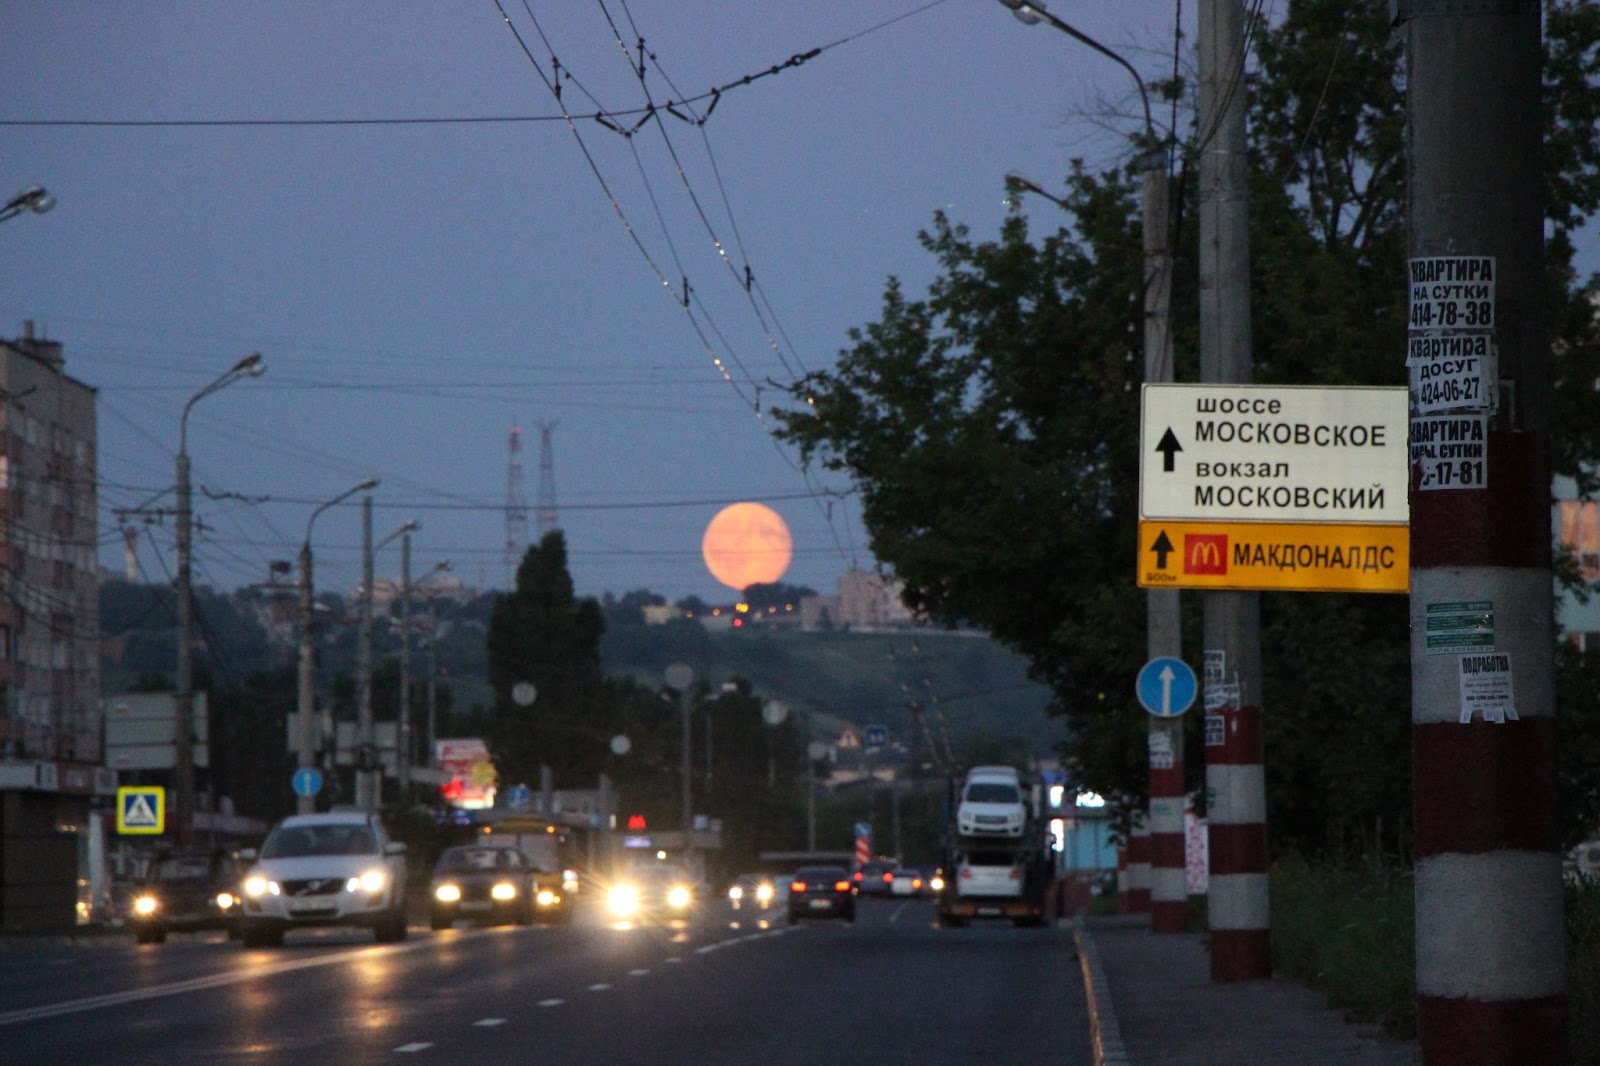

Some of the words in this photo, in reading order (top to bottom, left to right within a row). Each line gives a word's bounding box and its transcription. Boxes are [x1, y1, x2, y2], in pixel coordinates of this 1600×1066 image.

[1411, 259, 1492, 282] КВАРТИРА
[1414, 286, 1428, 300] НА
[1432, 285, 1488, 299] СУТКИ
[1411, 302, 1491, 326] 414-78-38
[1421, 377, 1480, 405] 424-06-27
[1196, 398, 1282, 414] шоссе
[1195, 420, 1387, 447] МОСКОВСКОЕ
[1440, 444, 1483, 458] СУТКИ
[1196, 462, 1290, 478] вокзал
[1194, 483, 1385, 510] МОСКОВСКИЙ
[1233, 543, 1395, 571] МАКДОНАЛДС
[1462, 655, 1509, 675] ПОДРАБОТКА
